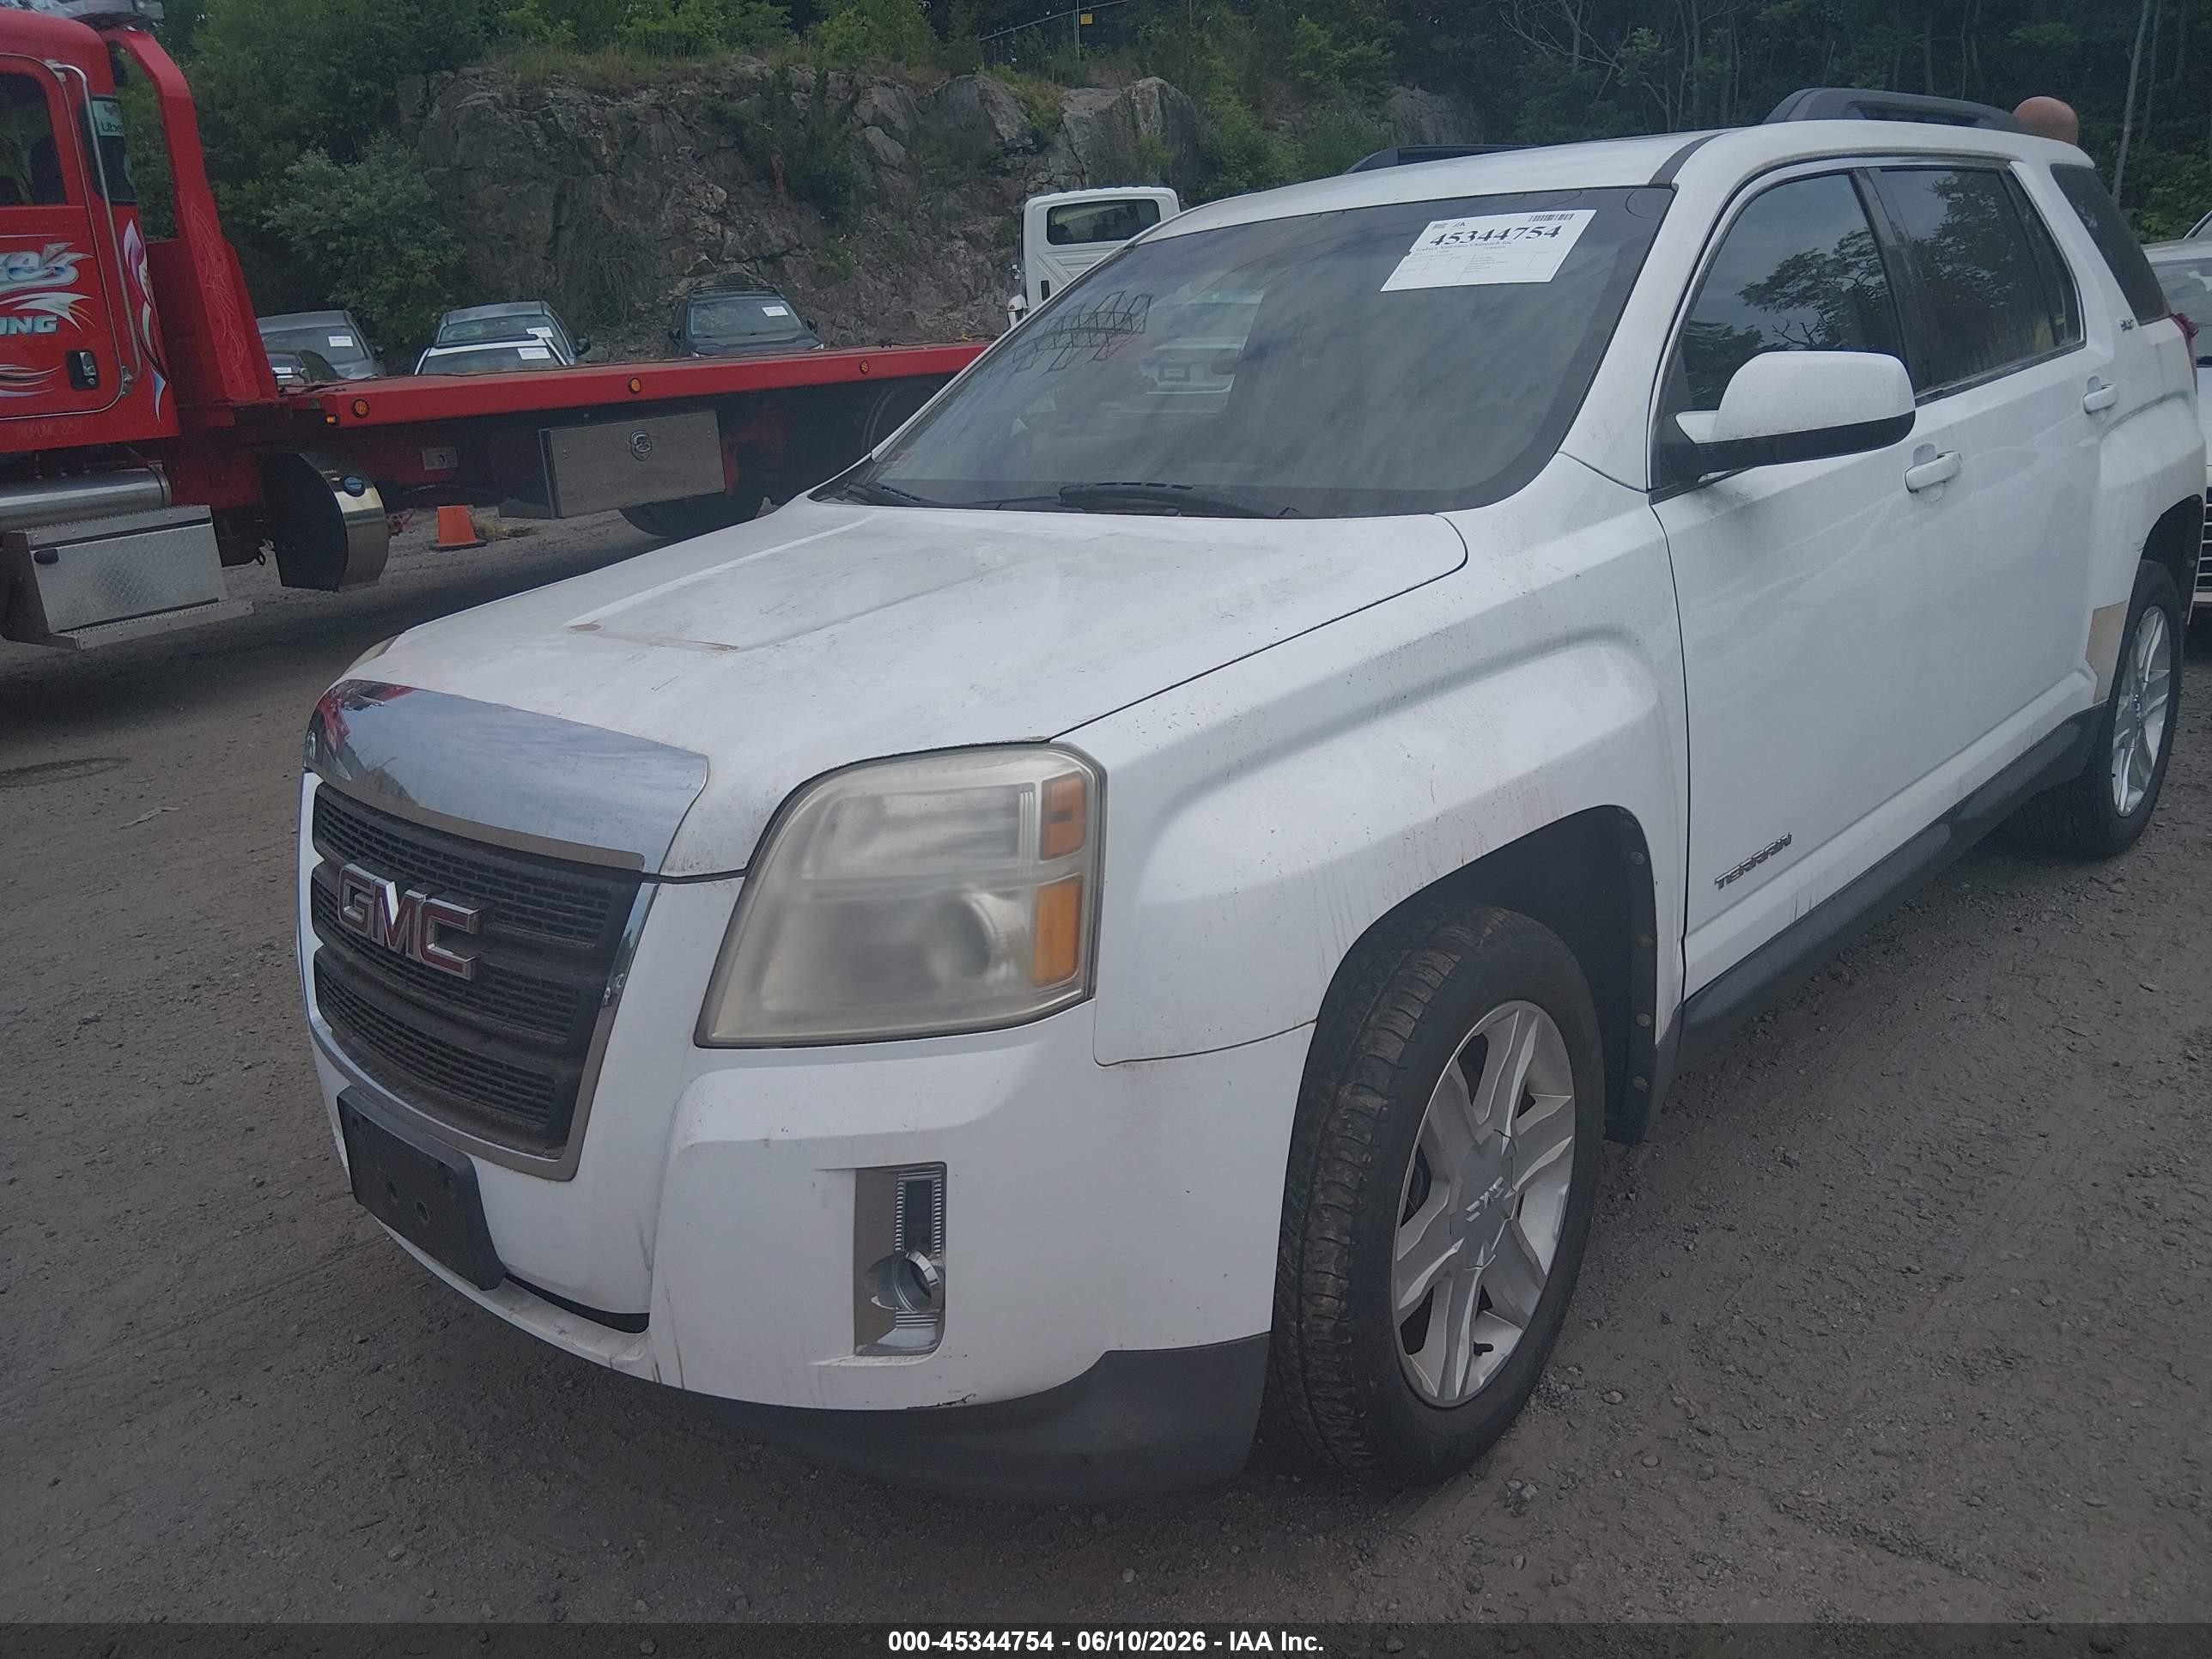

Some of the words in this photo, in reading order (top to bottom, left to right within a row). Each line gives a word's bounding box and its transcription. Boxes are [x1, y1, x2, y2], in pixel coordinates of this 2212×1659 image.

[100, 120, 124, 133] Ube
[1428, 224, 1563, 247] 45344754
[0, 241, 94, 295] e's
[1714, 831, 1792, 891] TERRAIN
[338, 862, 478, 981] GMC
